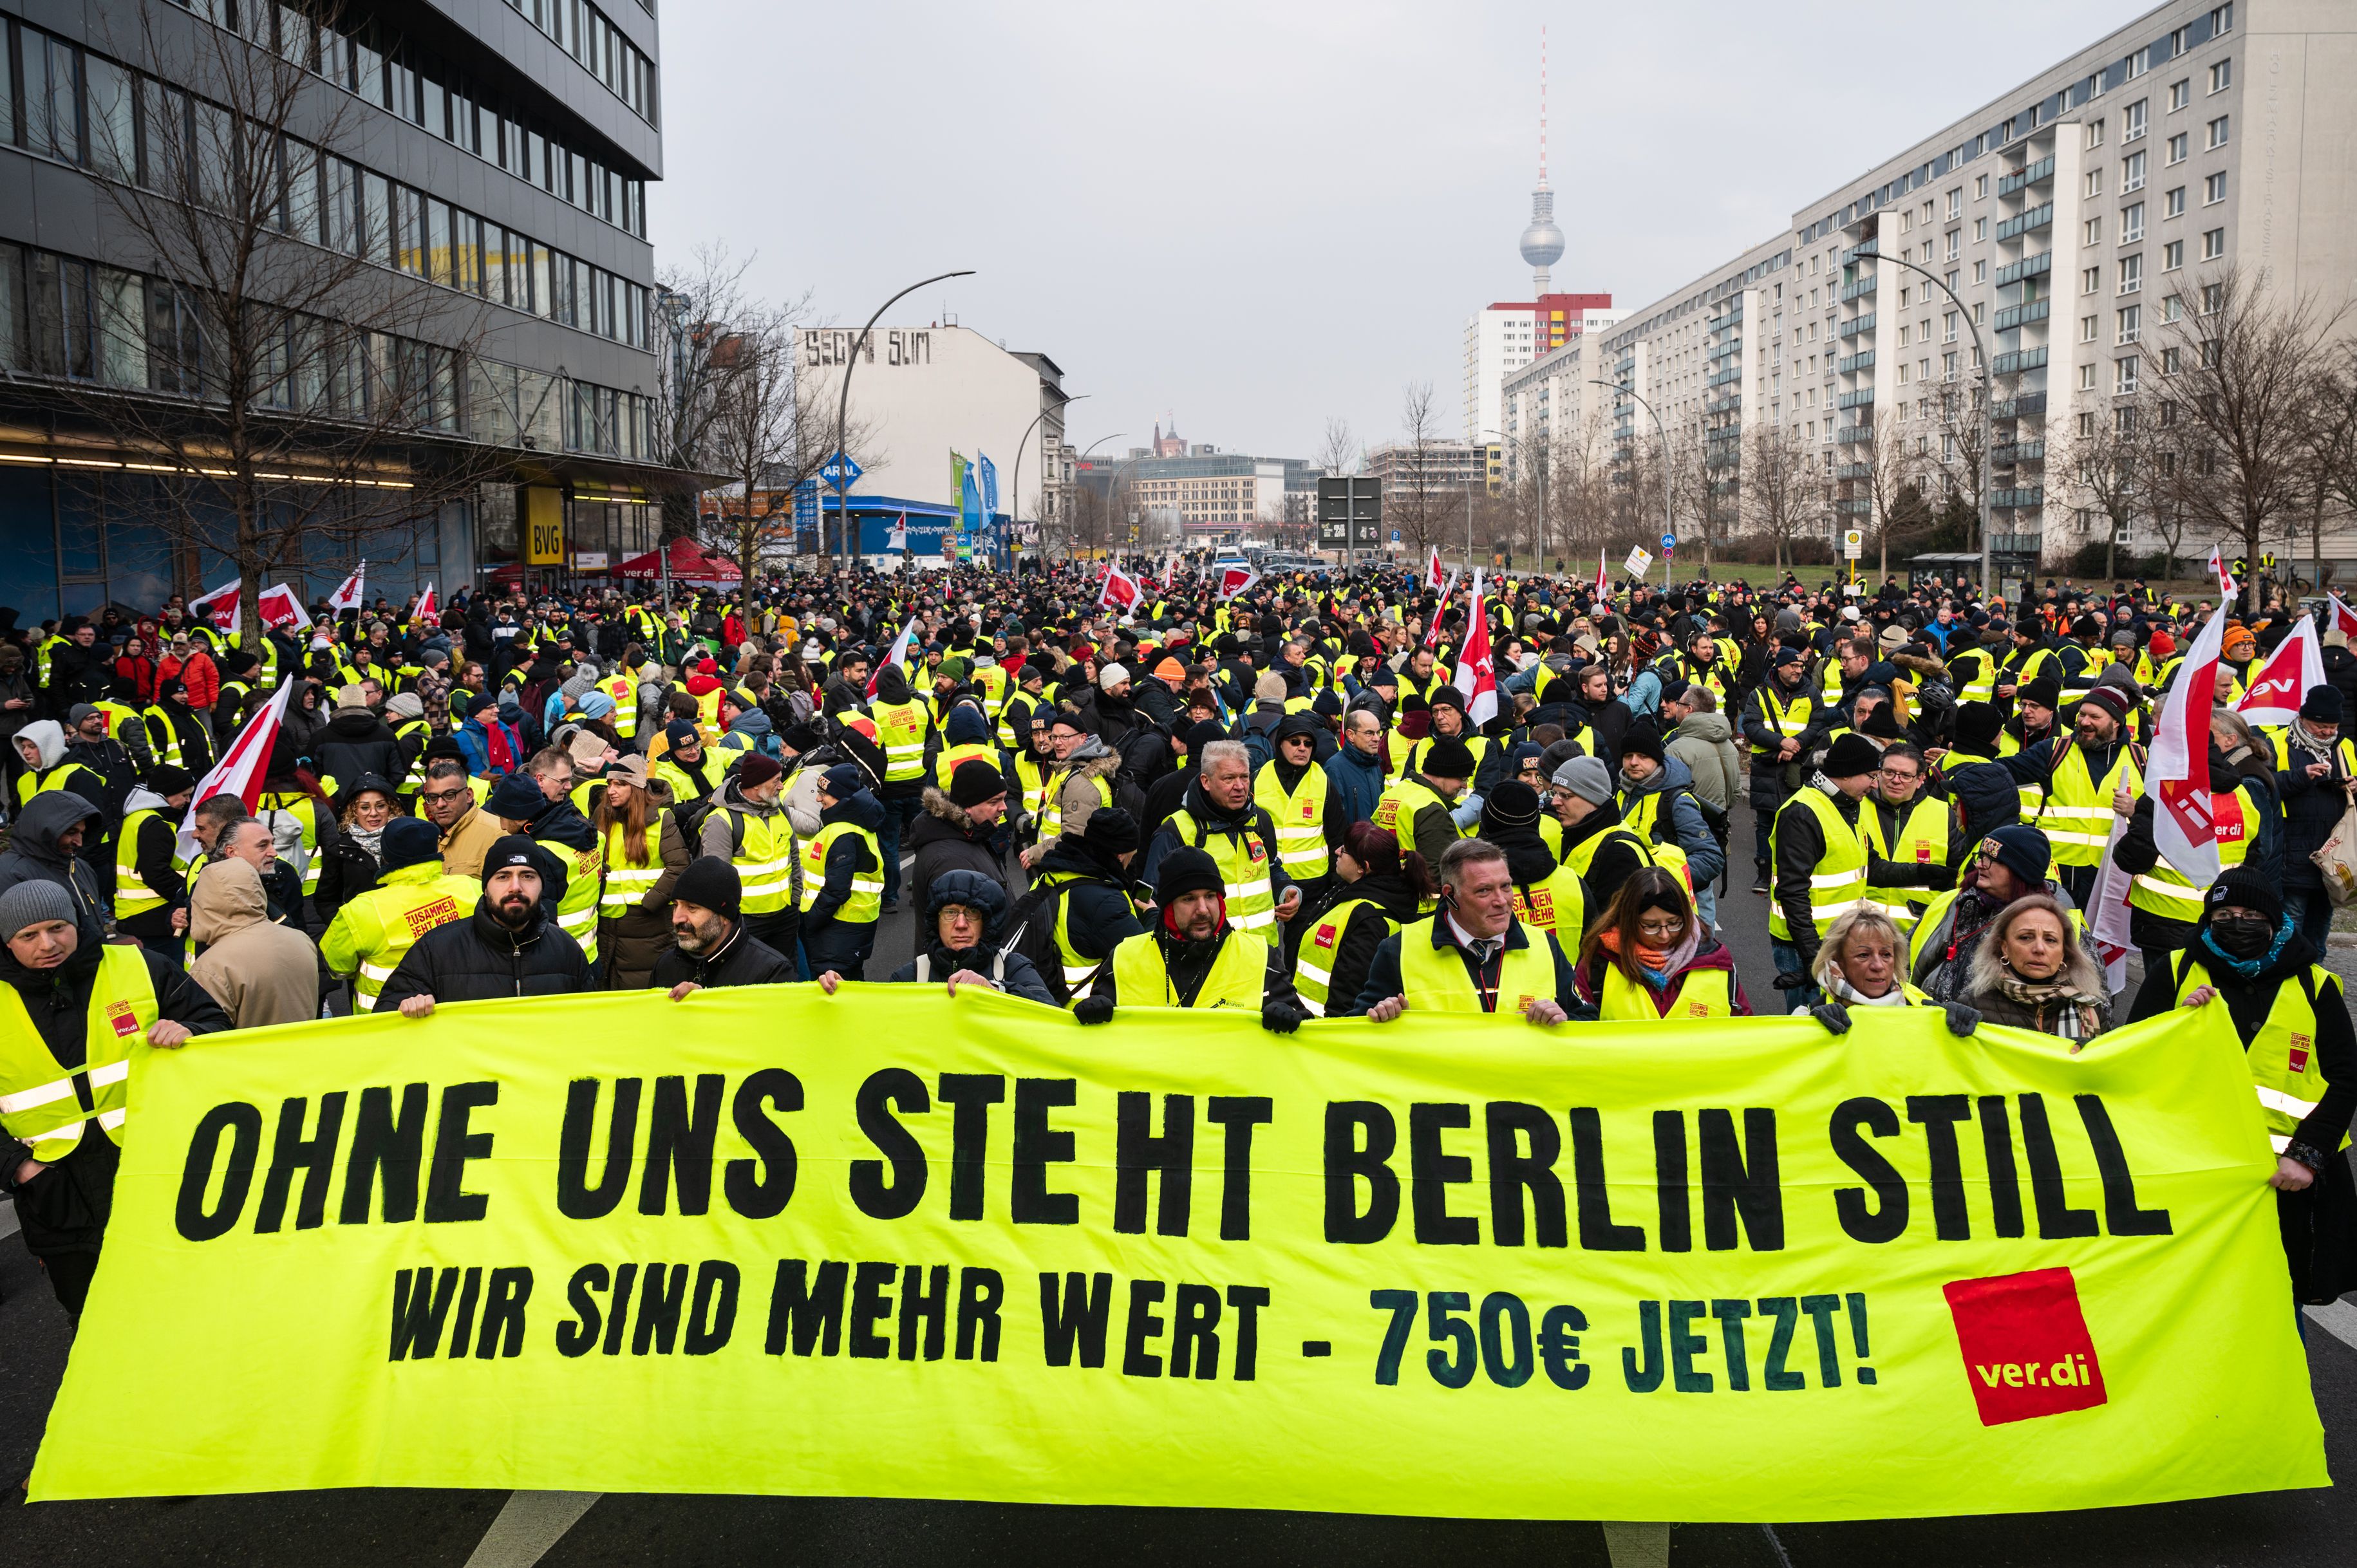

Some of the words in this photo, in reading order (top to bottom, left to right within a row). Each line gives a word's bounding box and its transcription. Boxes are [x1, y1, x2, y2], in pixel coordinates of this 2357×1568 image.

[534, 525, 559, 555] BVG
[889, 709, 914, 720] ZUSAMMEN
[890, 717, 903, 725] GEHT
[903, 715, 915, 723] MEHR
[579, 859, 590, 875] GEHT
[406, 899, 456, 927] ZUSAMMEN
[1529, 908, 1555, 923] MEHR
[1317, 934, 1332, 945] ver.di
[106, 1002, 129, 1013] ZUSAMMEN
[108, 1008, 118, 1018] GEHT
[118, 1005, 130, 1014] MEHR
[117, 1024, 138, 1034] ver.di
[2290, 1061, 2304, 1071] ver.di
[175, 1081, 498, 1242] OHNE
[558, 1069, 804, 1219] UNS
[1324, 1101, 1784, 1253] BERLIN
[1829, 1092, 2173, 1244] STILL
[389, 1267, 533, 1362] WIR
[556, 1260, 740, 1358] SIND
[765, 1259, 1004, 1362] MEHR
[1039, 1272, 1270, 1381] WERT
[1370, 1289, 1590, 1392] 750€
[1622, 1293, 1877, 1392] JETZT!
[1976, 1354, 2090, 1388] ver.di
